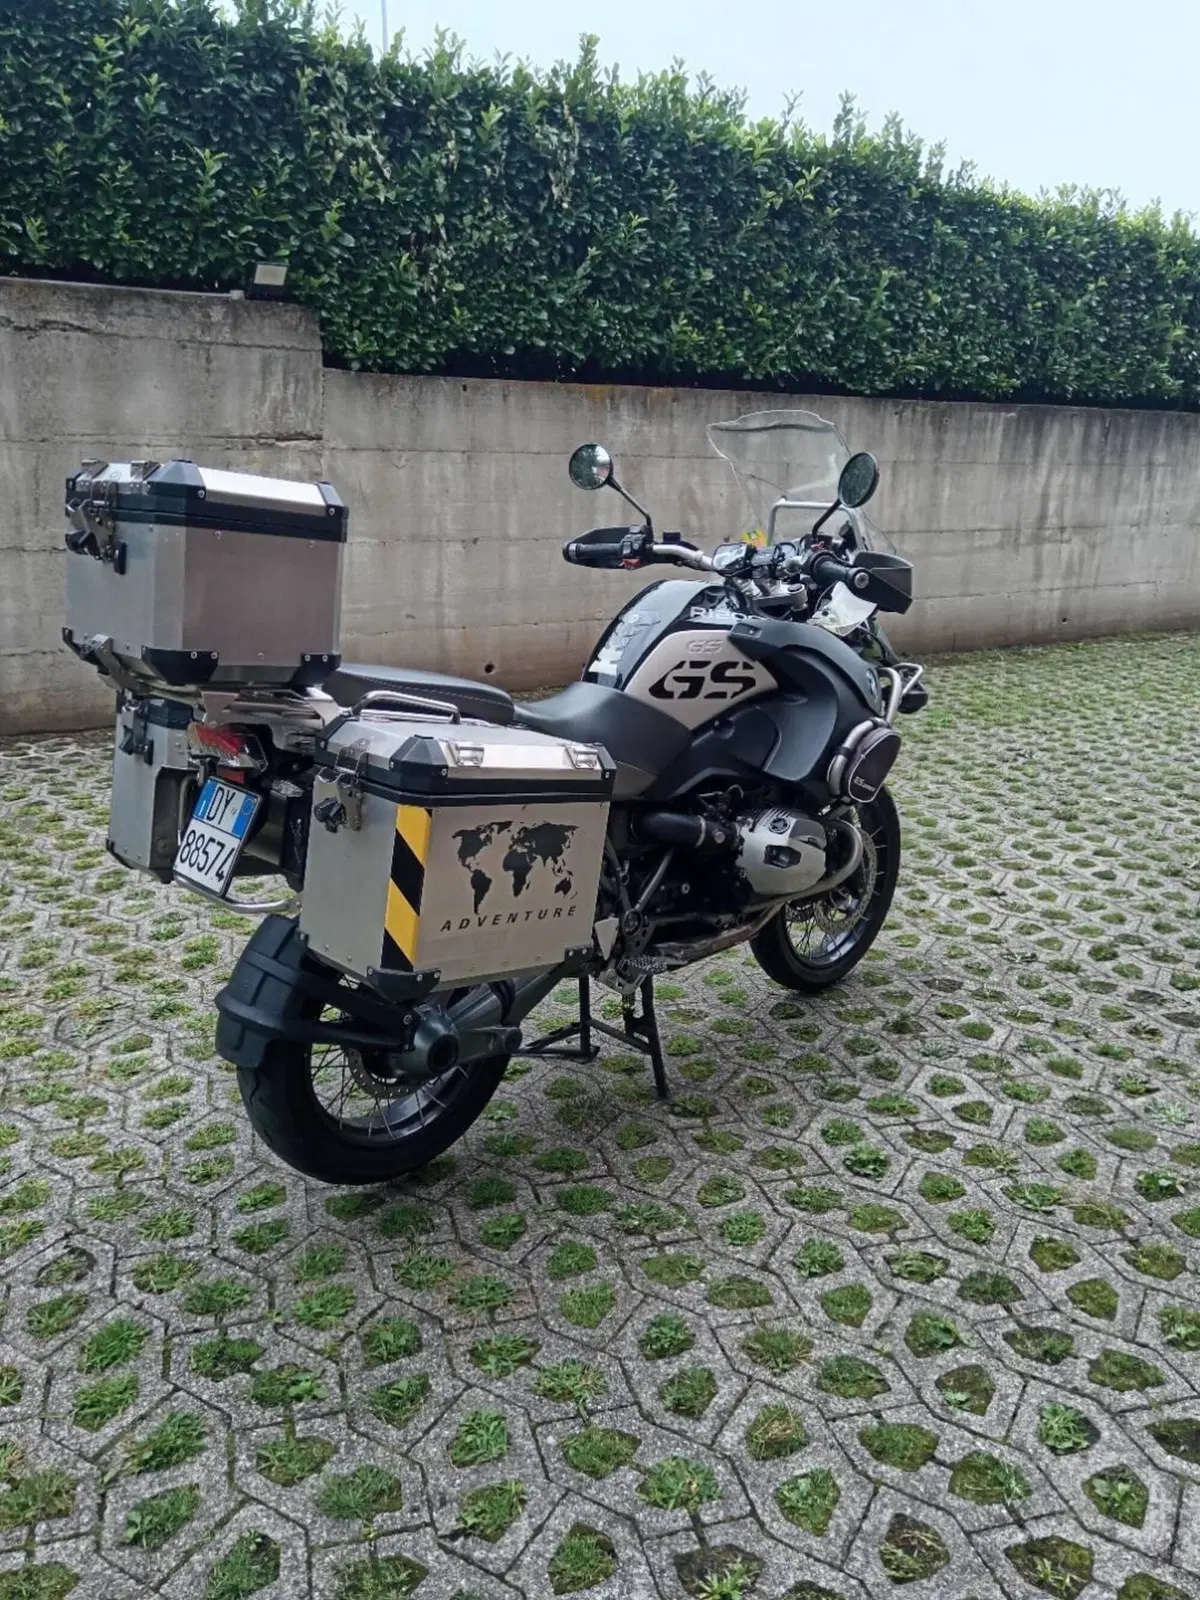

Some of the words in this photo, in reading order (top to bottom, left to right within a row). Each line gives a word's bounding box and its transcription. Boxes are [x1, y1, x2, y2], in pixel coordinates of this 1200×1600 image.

[686, 639, 724, 655] GS
[648, 660, 757, 699] GS
[206, 786, 236, 825] DY
[180, 829, 235, 883] 88574
[439, 905, 578, 933] ADVENTURE
